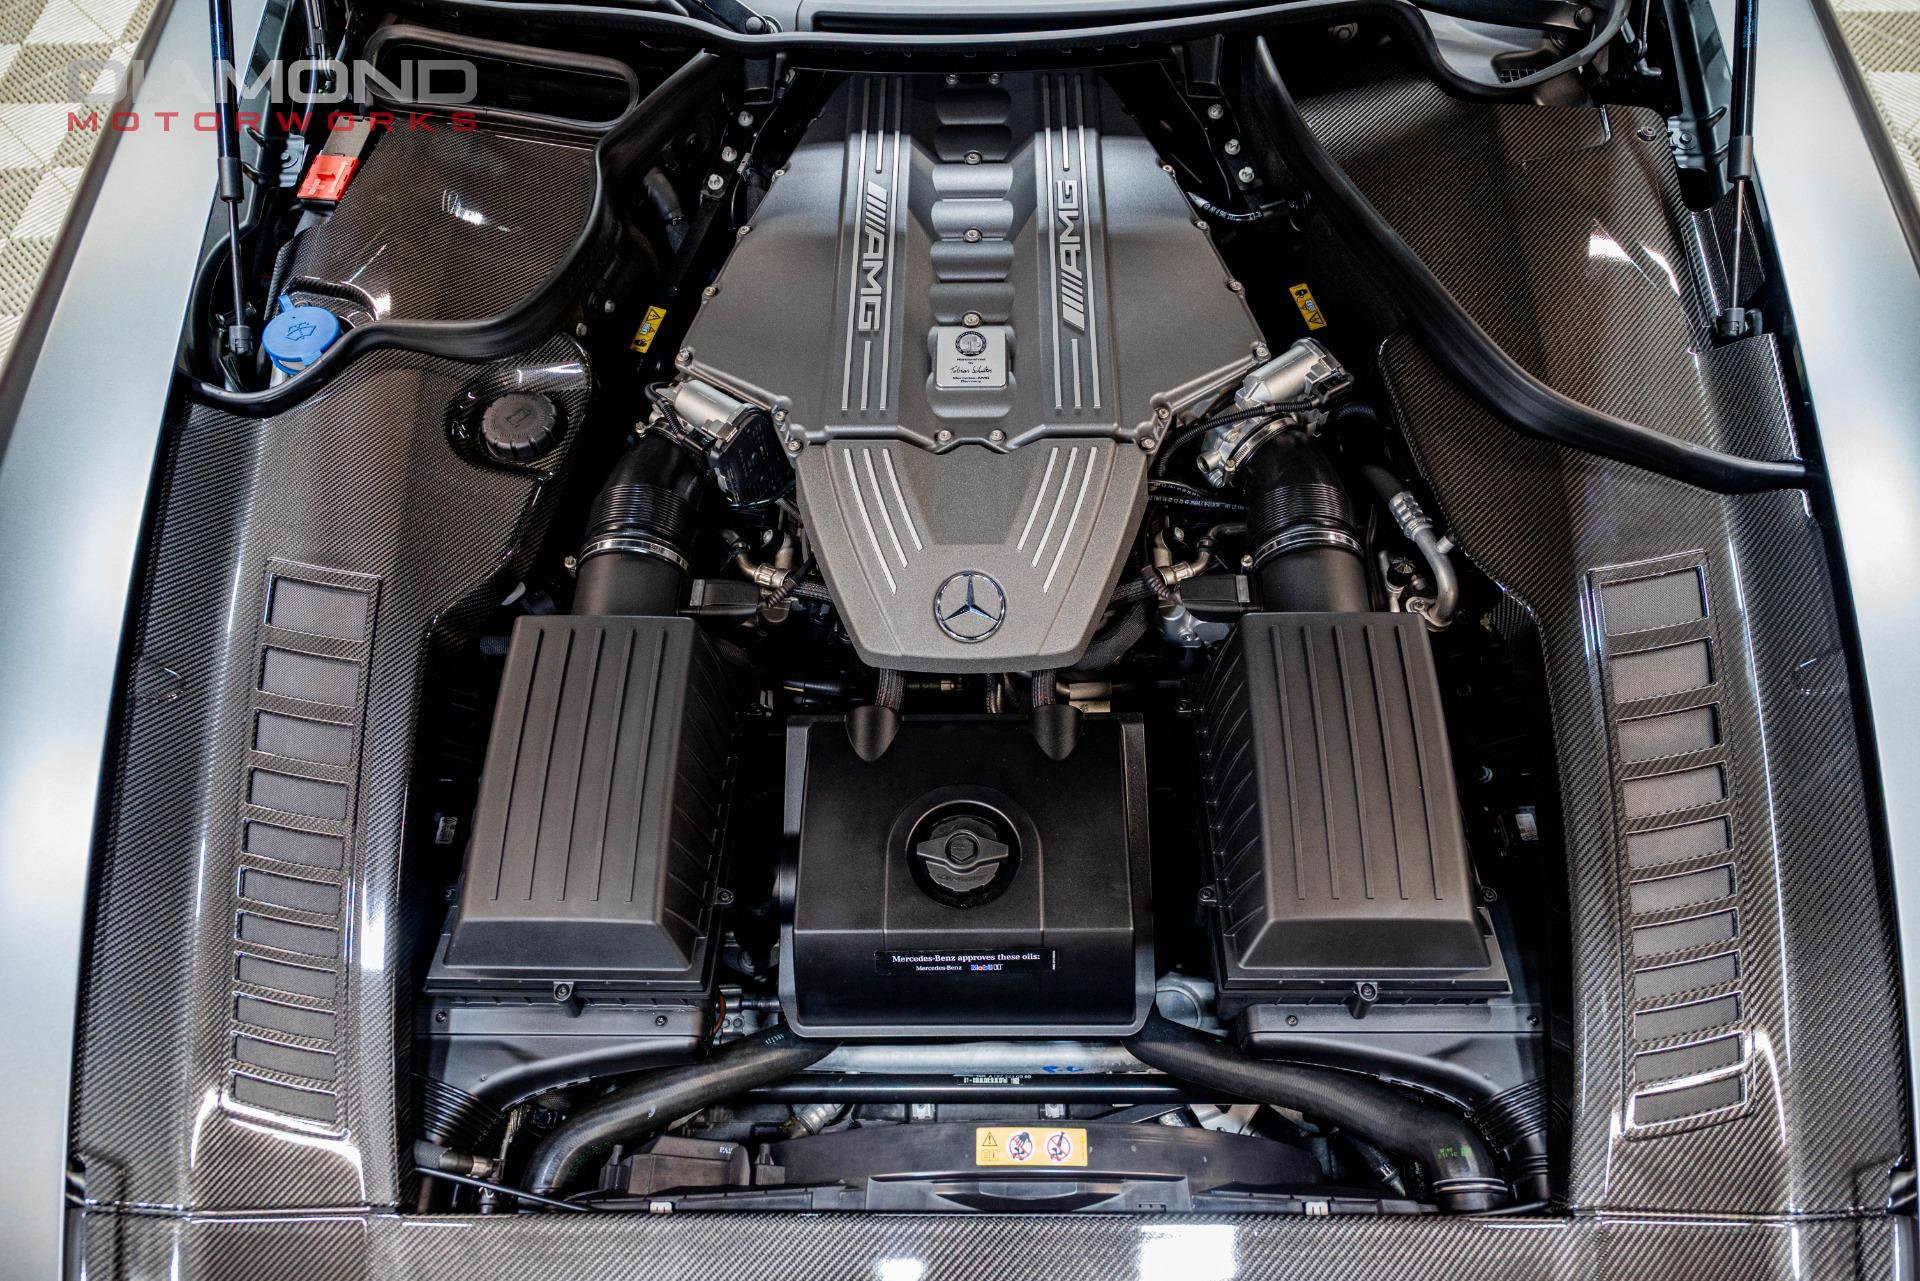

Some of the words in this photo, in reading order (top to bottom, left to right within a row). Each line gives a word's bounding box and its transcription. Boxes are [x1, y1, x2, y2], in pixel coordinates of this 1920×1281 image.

[858, 225, 886, 331] AMG
[1058, 180, 1083, 280] AMG
[892, 954, 956, 963] Mercedes-Benz
[957, 953, 995, 963] approves
[998, 953, 1020, 961] these
[1022, 952, 1041, 961] oils:
